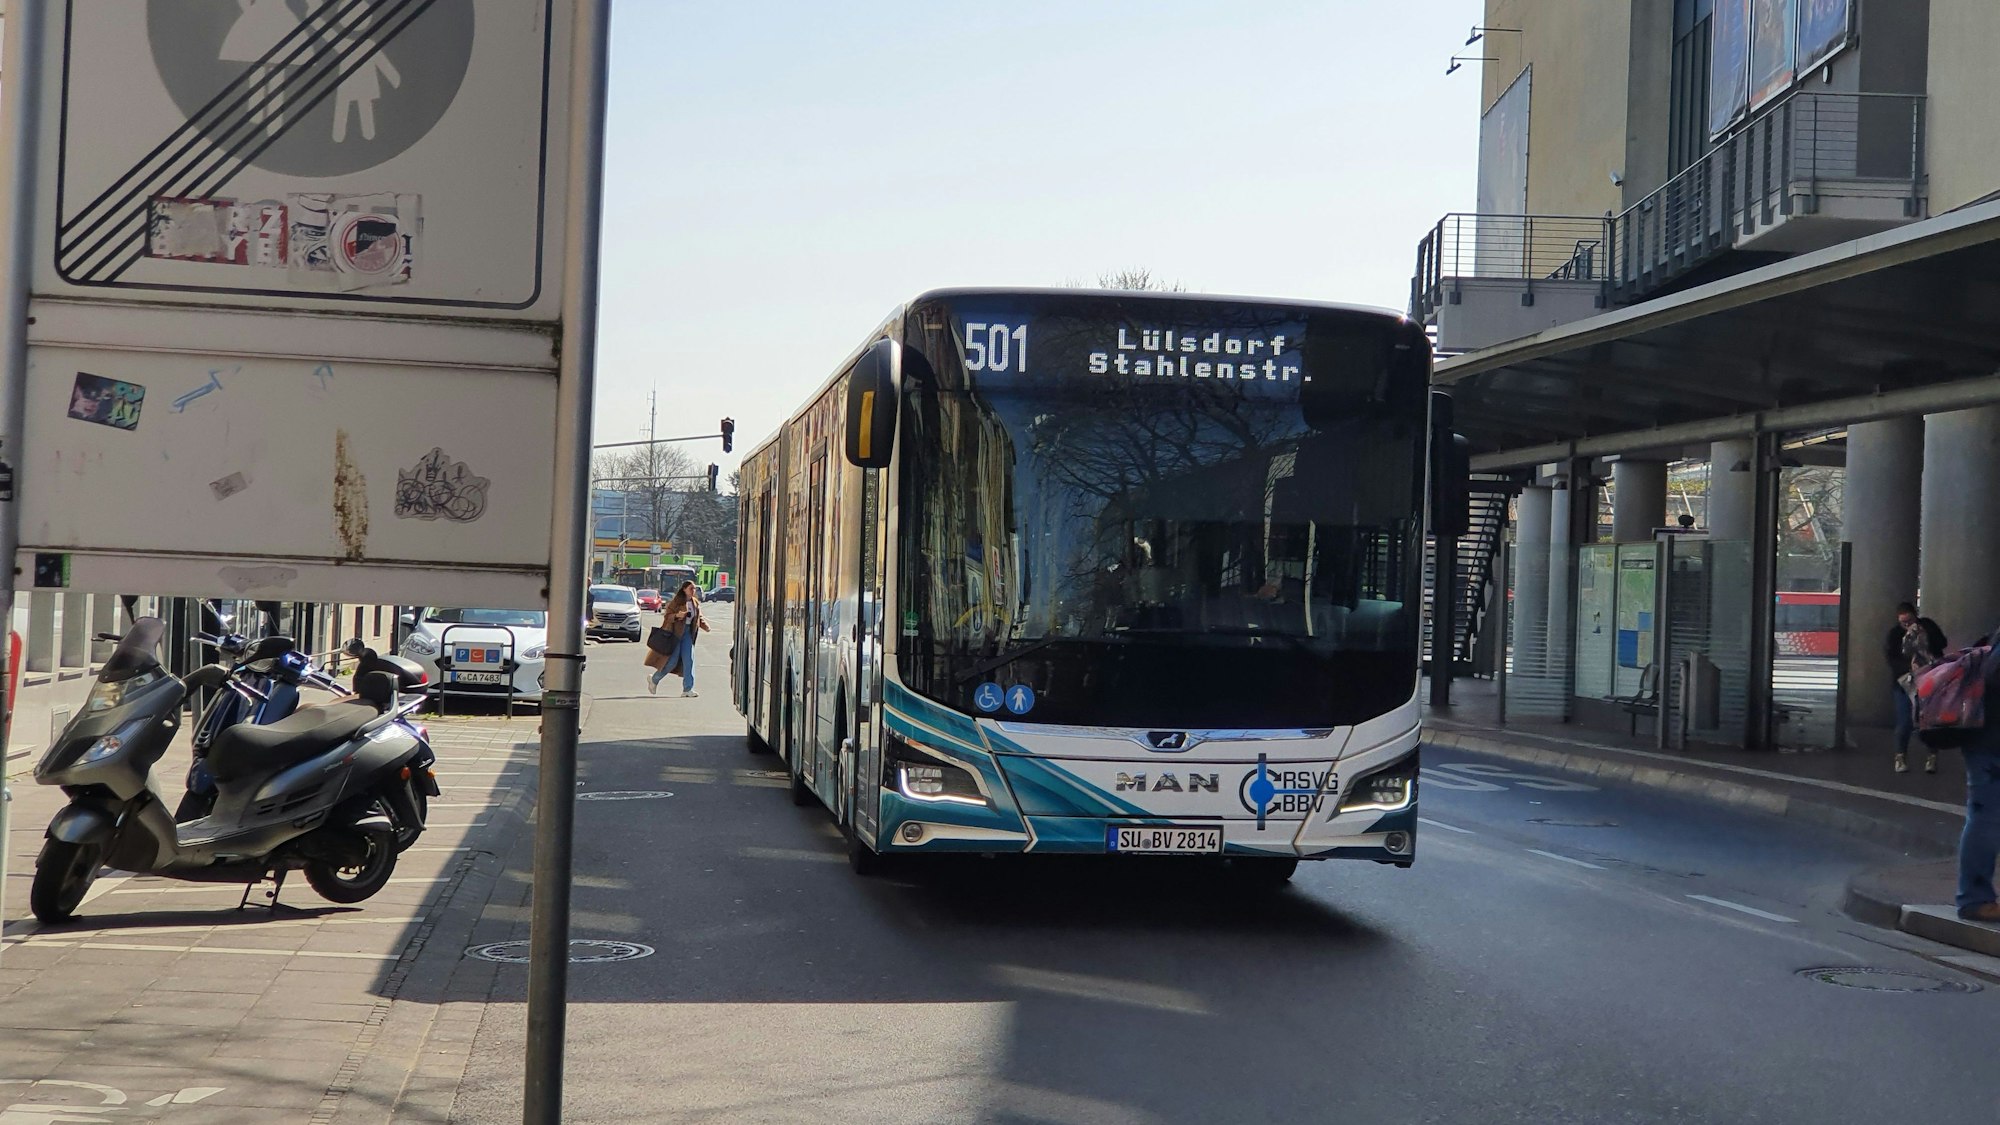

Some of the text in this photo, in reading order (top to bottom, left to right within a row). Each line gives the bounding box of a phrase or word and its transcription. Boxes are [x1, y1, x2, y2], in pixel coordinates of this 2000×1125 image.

[965, 323, 1027, 372] 501
[1118, 328, 1285, 355] Lülsdorf
[1089, 352, 1312, 382] Stahlenstr.
[467, 673, 478, 681] CA
[480, 673, 500, 682] 7483
[1115, 772, 1220, 793] MAN
[1283, 771, 1339, 790] RSVG
[1283, 795, 1324, 813] BBV
[1120, 830, 1216, 849] SU BV 2814
